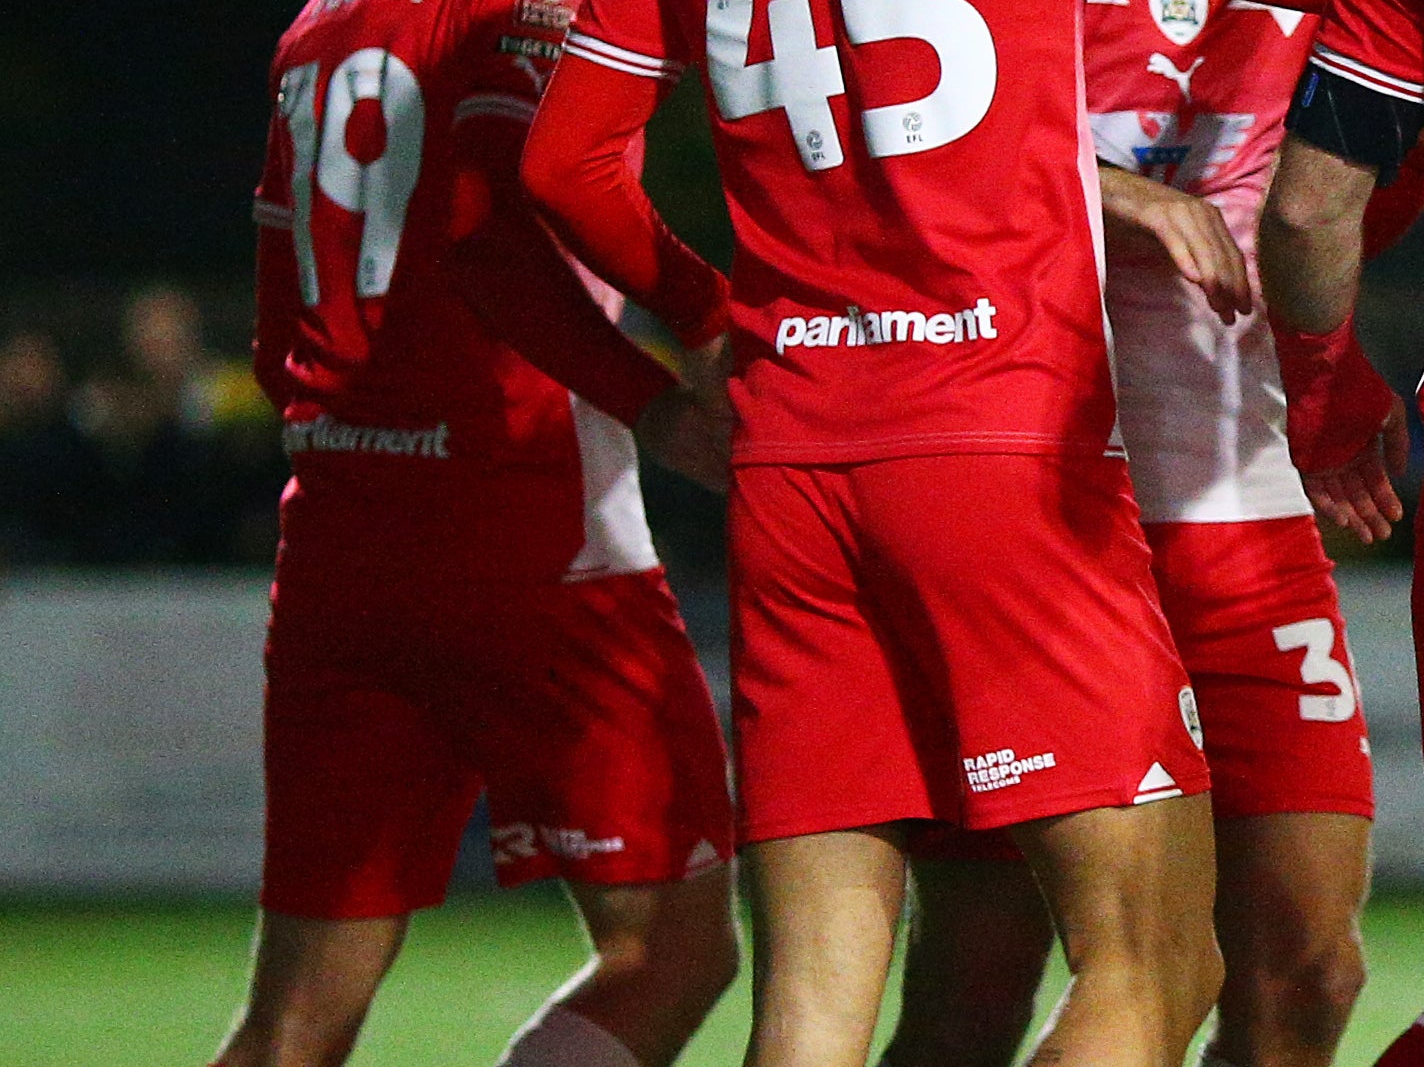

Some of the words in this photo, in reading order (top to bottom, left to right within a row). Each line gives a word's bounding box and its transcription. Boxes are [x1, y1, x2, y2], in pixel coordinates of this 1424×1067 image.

[278, 47, 425, 307] 19
[1271, 617, 1357, 722] 3
[963, 748, 1016, 772] RAPID
[967, 752, 1056, 785] RESPONSE
[971, 775, 1021, 793] TELECOMS
